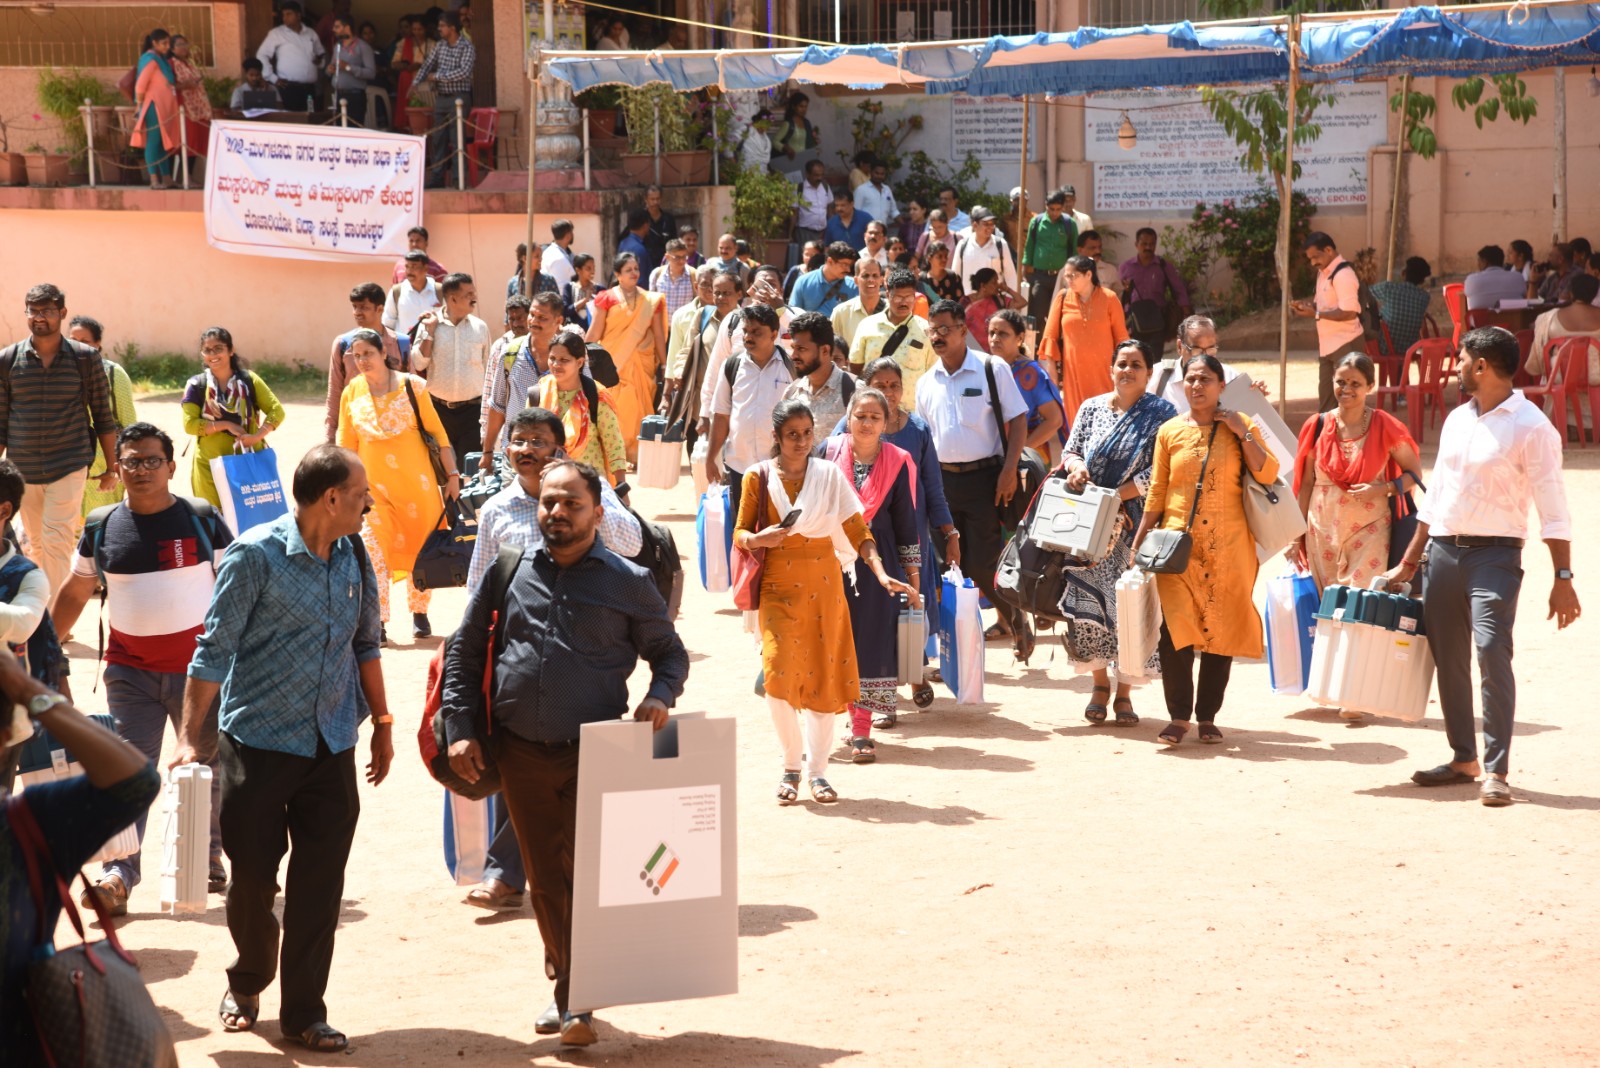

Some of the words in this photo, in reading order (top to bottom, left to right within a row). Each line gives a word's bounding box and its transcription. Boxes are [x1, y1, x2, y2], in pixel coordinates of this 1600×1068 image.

[296, 145, 314, 161] ನಗರ
[275, 183, 302, 207] ಮತ್ತು
[380, 185, 414, 213] ಕೇಂದ್ರ
[1327, 194, 1366, 203] GROUND
[174, 539, 184, 567] FASHION
